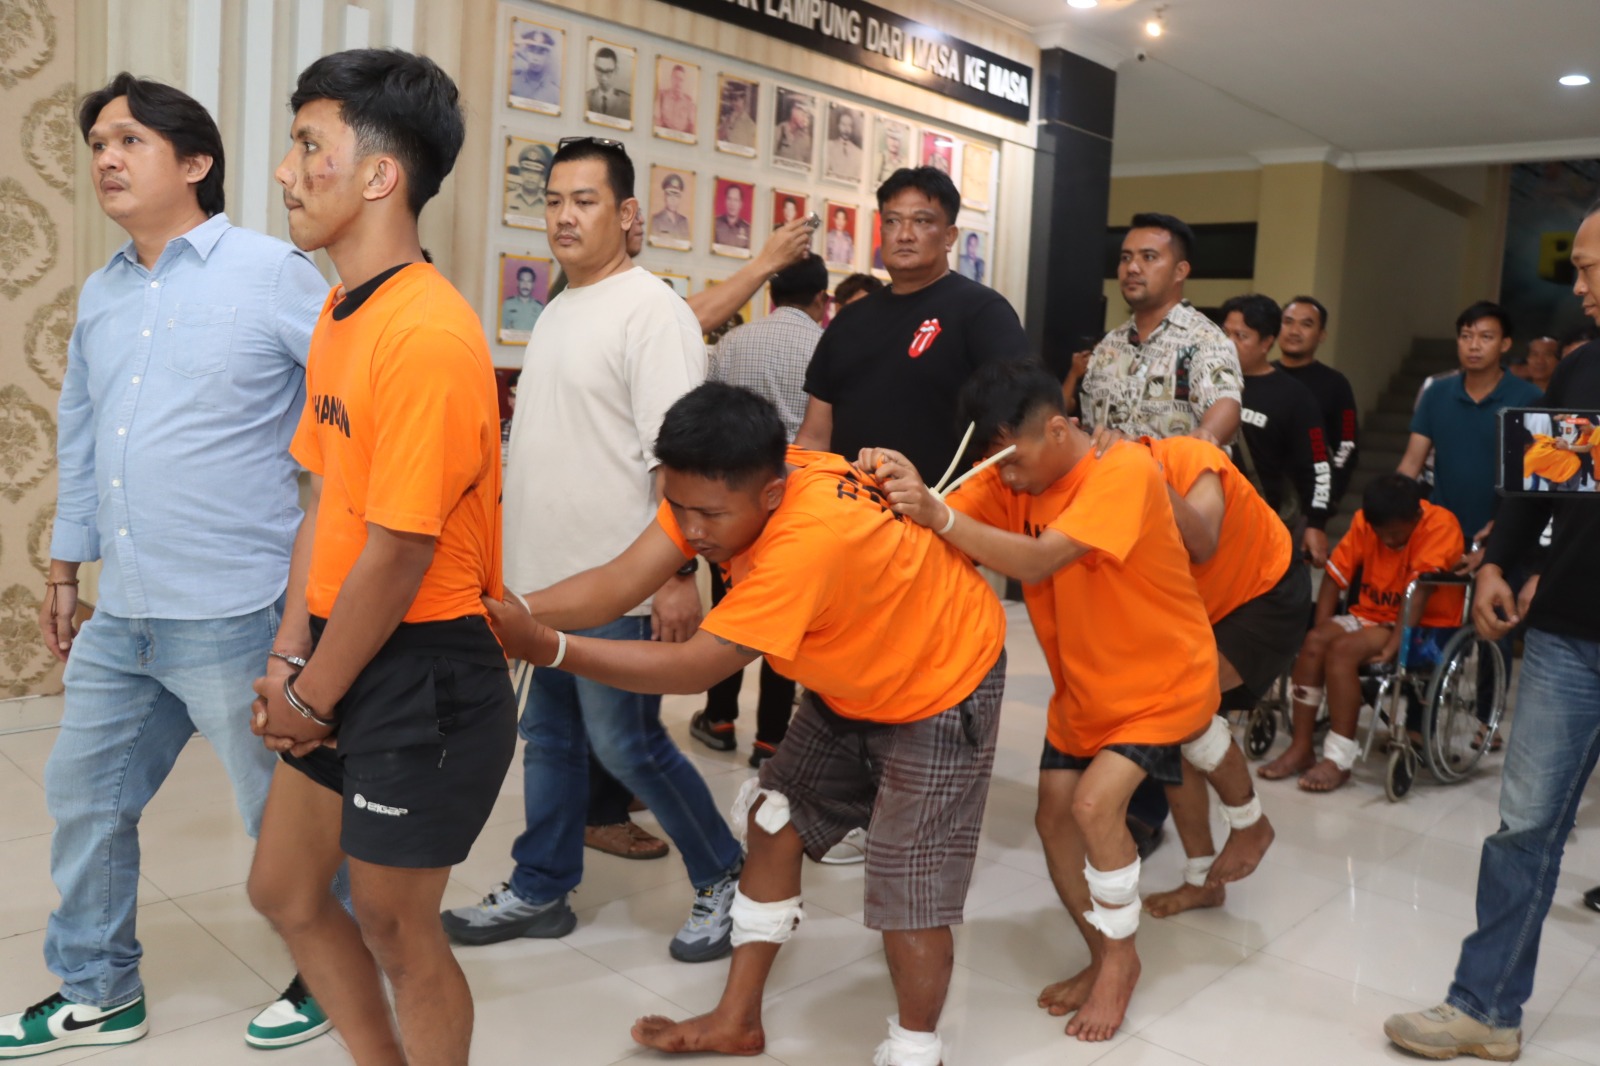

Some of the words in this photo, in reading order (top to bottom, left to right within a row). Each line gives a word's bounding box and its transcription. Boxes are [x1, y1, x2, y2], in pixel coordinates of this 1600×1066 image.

[866, 17, 906, 61] DARI
[913, 36, 960, 82] MASA
[964, 54, 986, 91] KE
[988, 62, 1029, 107] MASA
